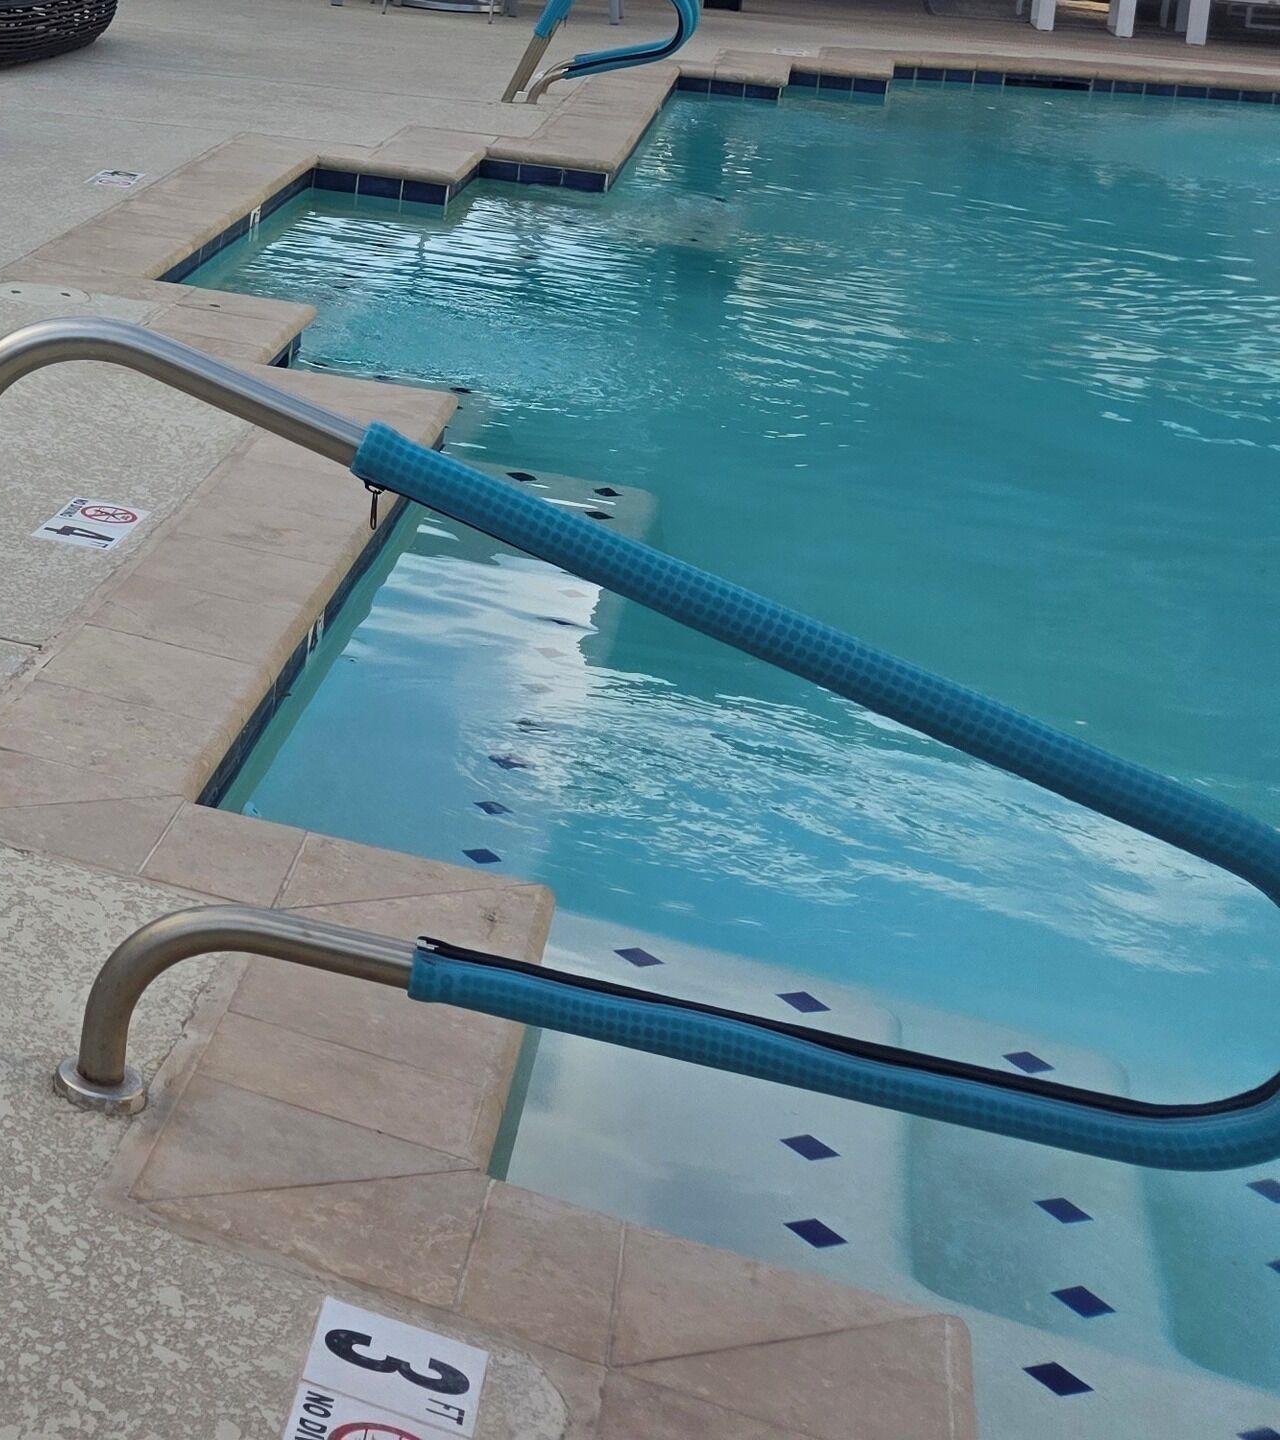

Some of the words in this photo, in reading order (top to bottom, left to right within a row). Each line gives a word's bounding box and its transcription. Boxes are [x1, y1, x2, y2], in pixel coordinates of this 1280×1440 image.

[44, 525, 115, 541] 4
[325, 1328, 470, 1395] 3
[425, 1398, 465, 1426] FT
[303, 1390, 335, 1418] NO
